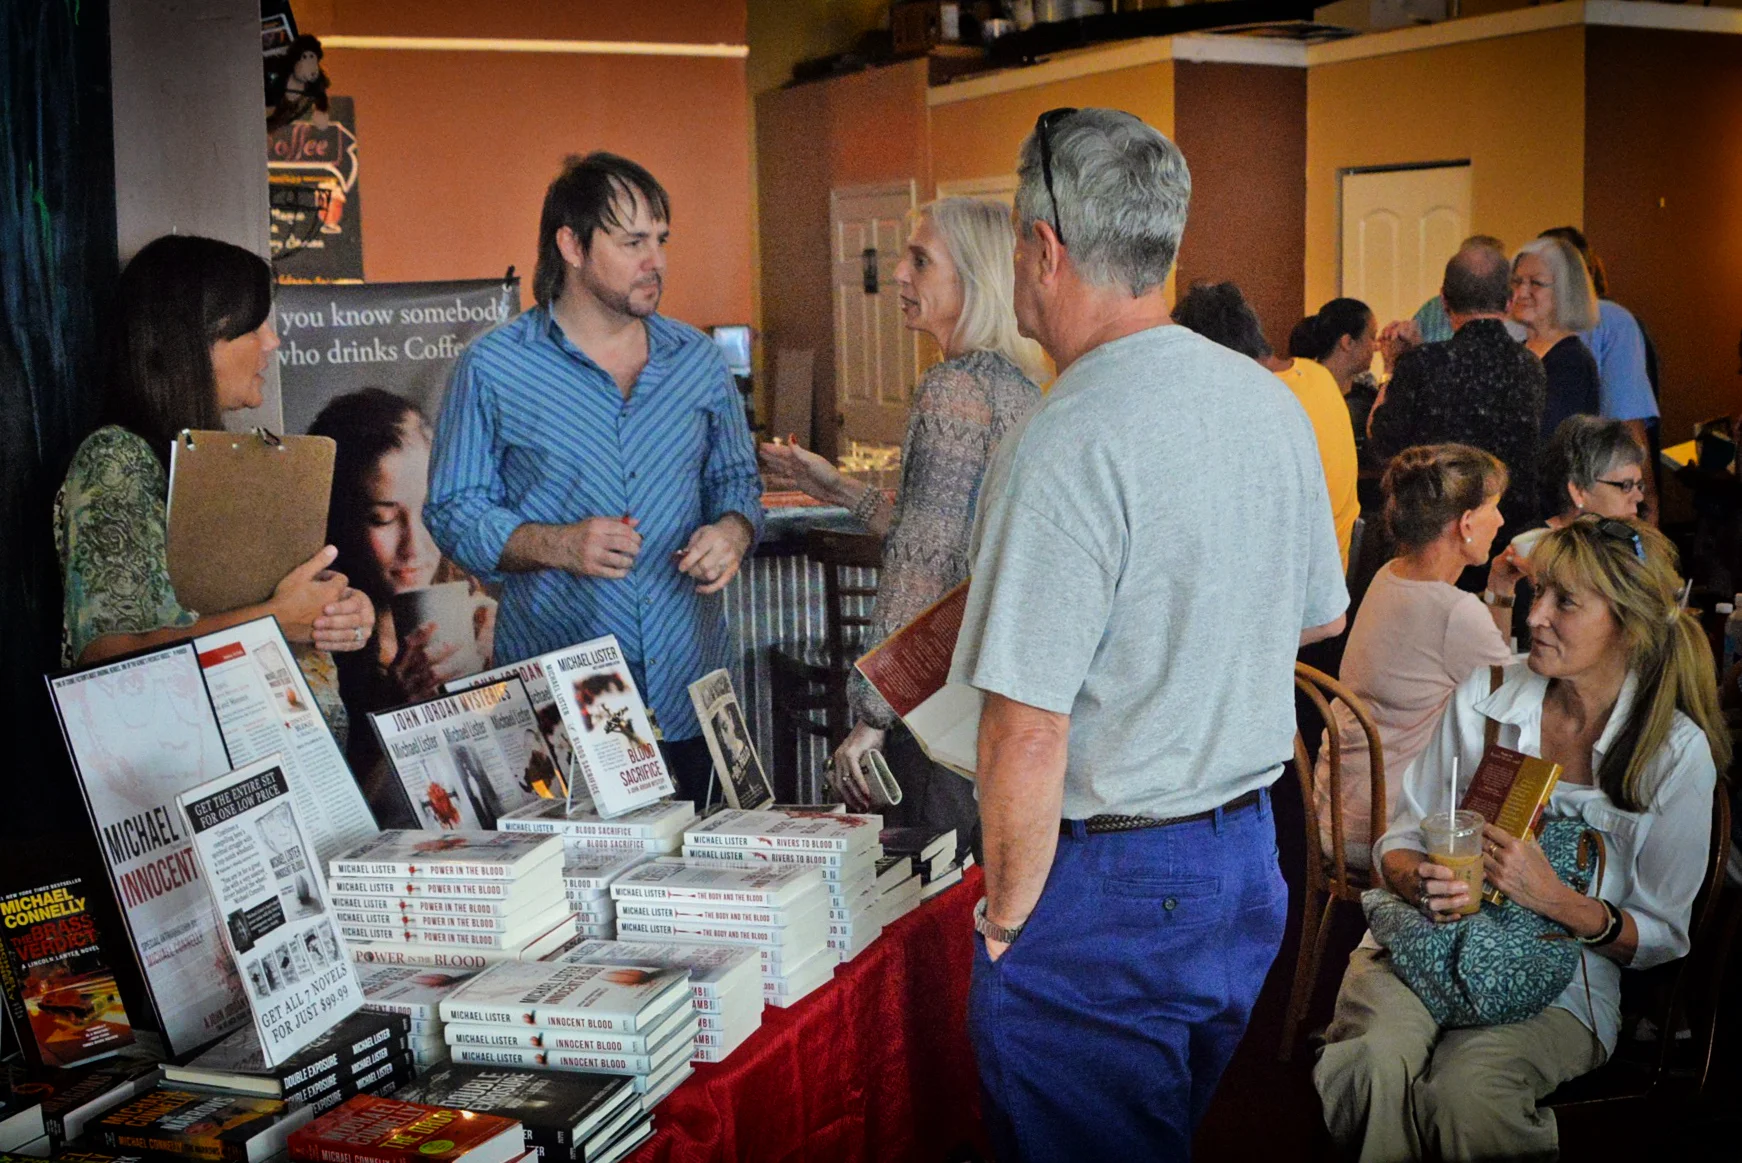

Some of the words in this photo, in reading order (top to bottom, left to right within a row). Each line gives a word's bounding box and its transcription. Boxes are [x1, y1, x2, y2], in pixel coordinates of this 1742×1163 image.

[268, 123, 328, 161] offee
[281, 310, 324, 336] you
[331, 302, 393, 327] know
[400, 297, 510, 324] somebody
[327, 338, 398, 364] drinks
[404, 334, 465, 360] Coffe
[557, 652, 594, 672] MICHAEL
[592, 646, 618, 664] LISTER
[392, 710, 422, 732] JOHN
[420, 698, 460, 724] JORDAN
[442, 725, 470, 743] Michael
[470, 720, 485, 738] Lister
[546, 664, 558, 693] MICHAEL
[557, 692, 570, 717] LISTER
[572, 737, 585, 759] BLOOD
[582, 759, 600, 795] SACRIFICE
[391, 739, 418, 758] Michael
[418, 734, 438, 752] Lister
[627, 743, 656, 764] BLOOD
[619, 761, 663, 787] SACRIFICE
[194, 800, 214, 817] GET
[215, 793, 232, 808] THE
[231, 781, 261, 801] ENTIRE
[262, 772, 276, 787] SET
[200, 814, 219, 829] FOR
[219, 806, 238, 820] ONE
[237, 797, 255, 812] LOW
[256, 785, 280, 804] PRICE
[103, 805, 179, 866] MICHAEL
[505, 823, 533, 832] MICHAEL
[534, 824, 554, 833] LISTER
[575, 826, 597, 835] BLOOD
[598, 827, 631, 836] SACRIFICE
[587, 840, 609, 848] BLOOD
[611, 840, 644, 849] SACRIFICE
[694, 836, 723, 845] MICHAEL
[724, 837, 748, 846] LISTER
[777, 838, 800, 847] RIVERS
[802, 839, 811, 848] TO
[813, 839, 833, 849] BLOOD
[338, 864, 369, 874] MICHAEL
[371, 865, 396, 875] LISTER
[430, 865, 454, 875] POWER
[456, 866, 464, 875] IN
[466, 866, 479, 875] THE
[481, 866, 504, 876] BLOOD
[689, 850, 717, 860] MICHAEL
[719, 851, 743, 860] LISTER
[772, 853, 794, 863] RIVERS
[797, 854, 804, 863] TO
[806, 855, 827, 865] BLOOD
[33, 885, 50, 893] TIMES
[50, 877, 82, 890] BESTSELLER
[119, 847, 199, 908] INNOCENT
[336, 882, 368, 892] MICHAEL
[369, 883, 394, 893] LISTER
[428, 884, 451, 894] POWER
[453, 884, 461, 894] IN
[462, 885, 477, 894] THE
[478, 885, 501, 895] BLOOD
[570, 880, 591, 888] BLOOD
[0, 887, 74, 916] MICHAEL
[332, 898, 361, 908] MICHAEL
[363, 899, 388, 909] LISTER
[420, 901, 443, 911] POWER
[444, 902, 452, 911] IN
[453, 902, 467, 912] THE
[469, 903, 491, 914] BLOOD
[615, 888, 642, 898] MICHAEL
[643, 888, 666, 898] LISTER
[697, 892, 707, 900] THE
[709, 892, 722, 900] BODY
[723, 893, 734, 901] AND
[746, 894, 763, 902] BLOOD
[4, 896, 86, 929] CONNELLY
[366, 914, 391, 924] LISTER
[422, 917, 446, 926] POWER
[448, 917, 455, 927] IN
[456, 917, 470, 927] THE
[471, 918, 494, 928] BLOOD
[10, 933, 32, 947] THE
[31, 913, 94, 941] BRASS
[621, 924, 647, 933] MICHAEL
[650, 925, 672, 934] LISTER
[703, 929, 713, 937] THE
[714, 929, 727, 938] BODY
[729, 930, 739, 938] AND
[740, 930, 750, 939] THE
[751, 931, 768, 940] BLOOD
[15, 928, 97, 961] VERDICT
[27, 956, 54, 968] LINCOLN
[55, 950, 81, 961] LAWYER
[80, 945, 100, 955] NOVEL
[355, 950, 405, 966] POWER
[418, 956, 433, 964] THE
[435, 950, 486, 968] BLOOD
[262, 1010, 282, 1028] GET
[285, 997, 304, 1014] ALL
[305, 990, 310, 1003] 7
[311, 963, 347, 993] NOVELS
[692, 1000, 709, 1010] AMB
[272, 1024, 294, 1043] FOR
[296, 1004, 319, 1026] JUST
[321, 985, 348, 1013] $99.99
[389, 1006, 411, 1016] BLOOD
[451, 1010, 483, 1022] MICHAEL
[485, 1012, 511, 1023] LISTER
[548, 1017, 586, 1028] INNOCENT
[588, 1018, 613, 1030] BLOOD
[456, 1033, 488, 1045] MICHAEL
[490, 1035, 518, 1046] LISTER
[555, 1039, 594, 1050] INNOCENT
[597, 1040, 622, 1052] BLOOD
[693, 1034, 710, 1044] AMB
[284, 1067, 307, 1089] DOUBLE
[308, 1053, 338, 1080] EXPOSURE
[352, 1036, 373, 1055] MICHAEL
[372, 1028, 391, 1045] LISTER
[307, 1072, 338, 1099] EXPOSURE
[352, 1055, 372, 1074] MICHAEL
[372, 1047, 388, 1064] LISTER
[313, 1089, 342, 1115] EXPOSURE
[356, 1071, 377, 1089] MICHAEL
[376, 1062, 393, 1079] LISTER
[439, 1071, 505, 1108] DOUBLE
[467, 1072, 534, 1111] EXPOSURE
[320, 1103, 404, 1142] MICHAEL
[347, 1105, 426, 1146] CONNELLY
[379, 1133, 423, 1149] THE
[322, 1150, 352, 1163] MICHAEL
